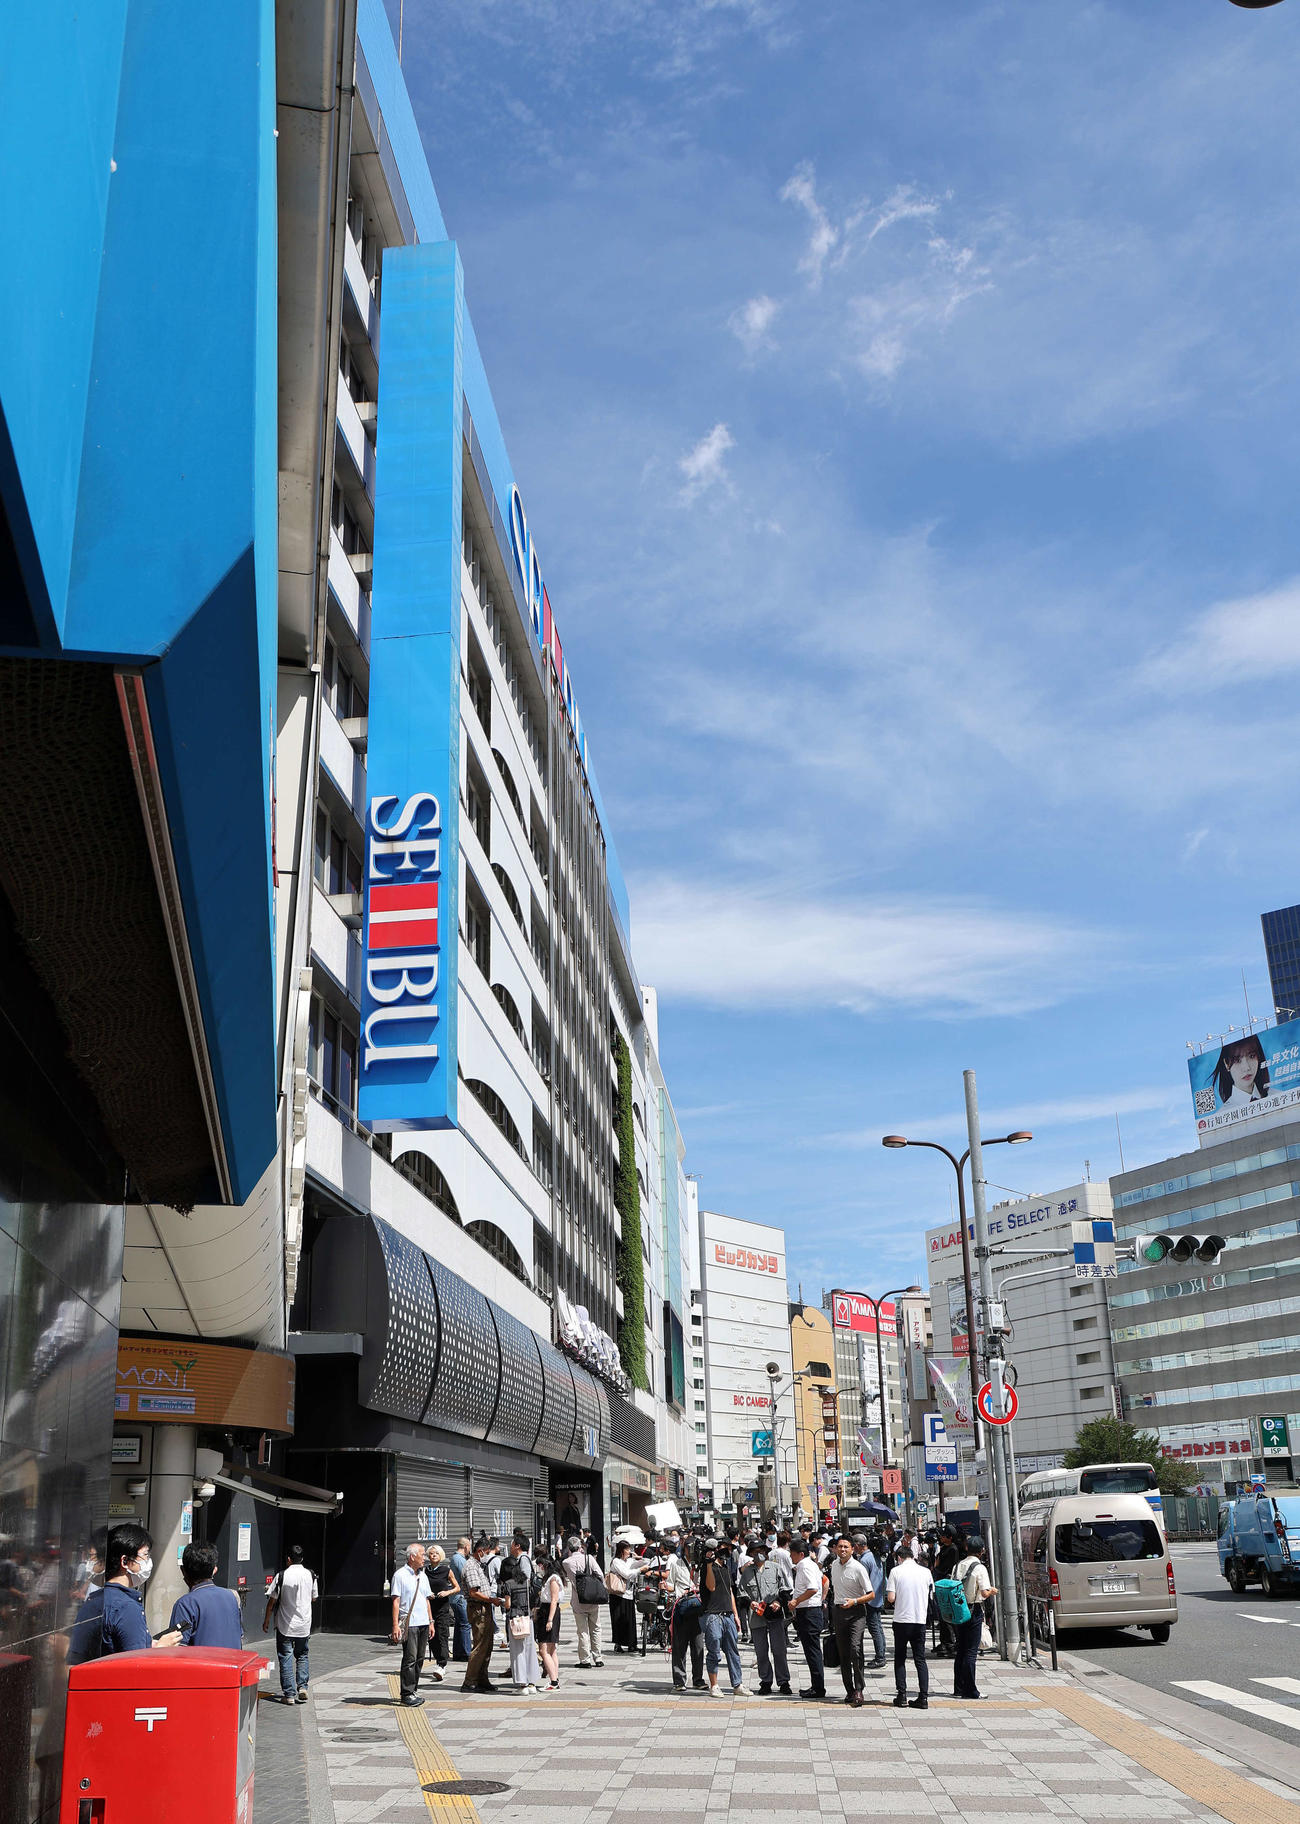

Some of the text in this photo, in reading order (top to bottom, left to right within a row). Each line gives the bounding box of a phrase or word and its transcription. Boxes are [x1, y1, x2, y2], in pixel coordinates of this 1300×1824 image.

[364, 793, 441, 1071] SEIBU
[1007, 1207, 1050, 1229] SELECT
[715, 1244, 778, 1273] ビックカメラ
[1077, 1265, 1115, 1278] 時差式
[734, 1394, 745, 1407] BIC
[1162, 1441, 1227, 1458] ビックカメラ
[417, 1506, 448, 1540] SEIBU
